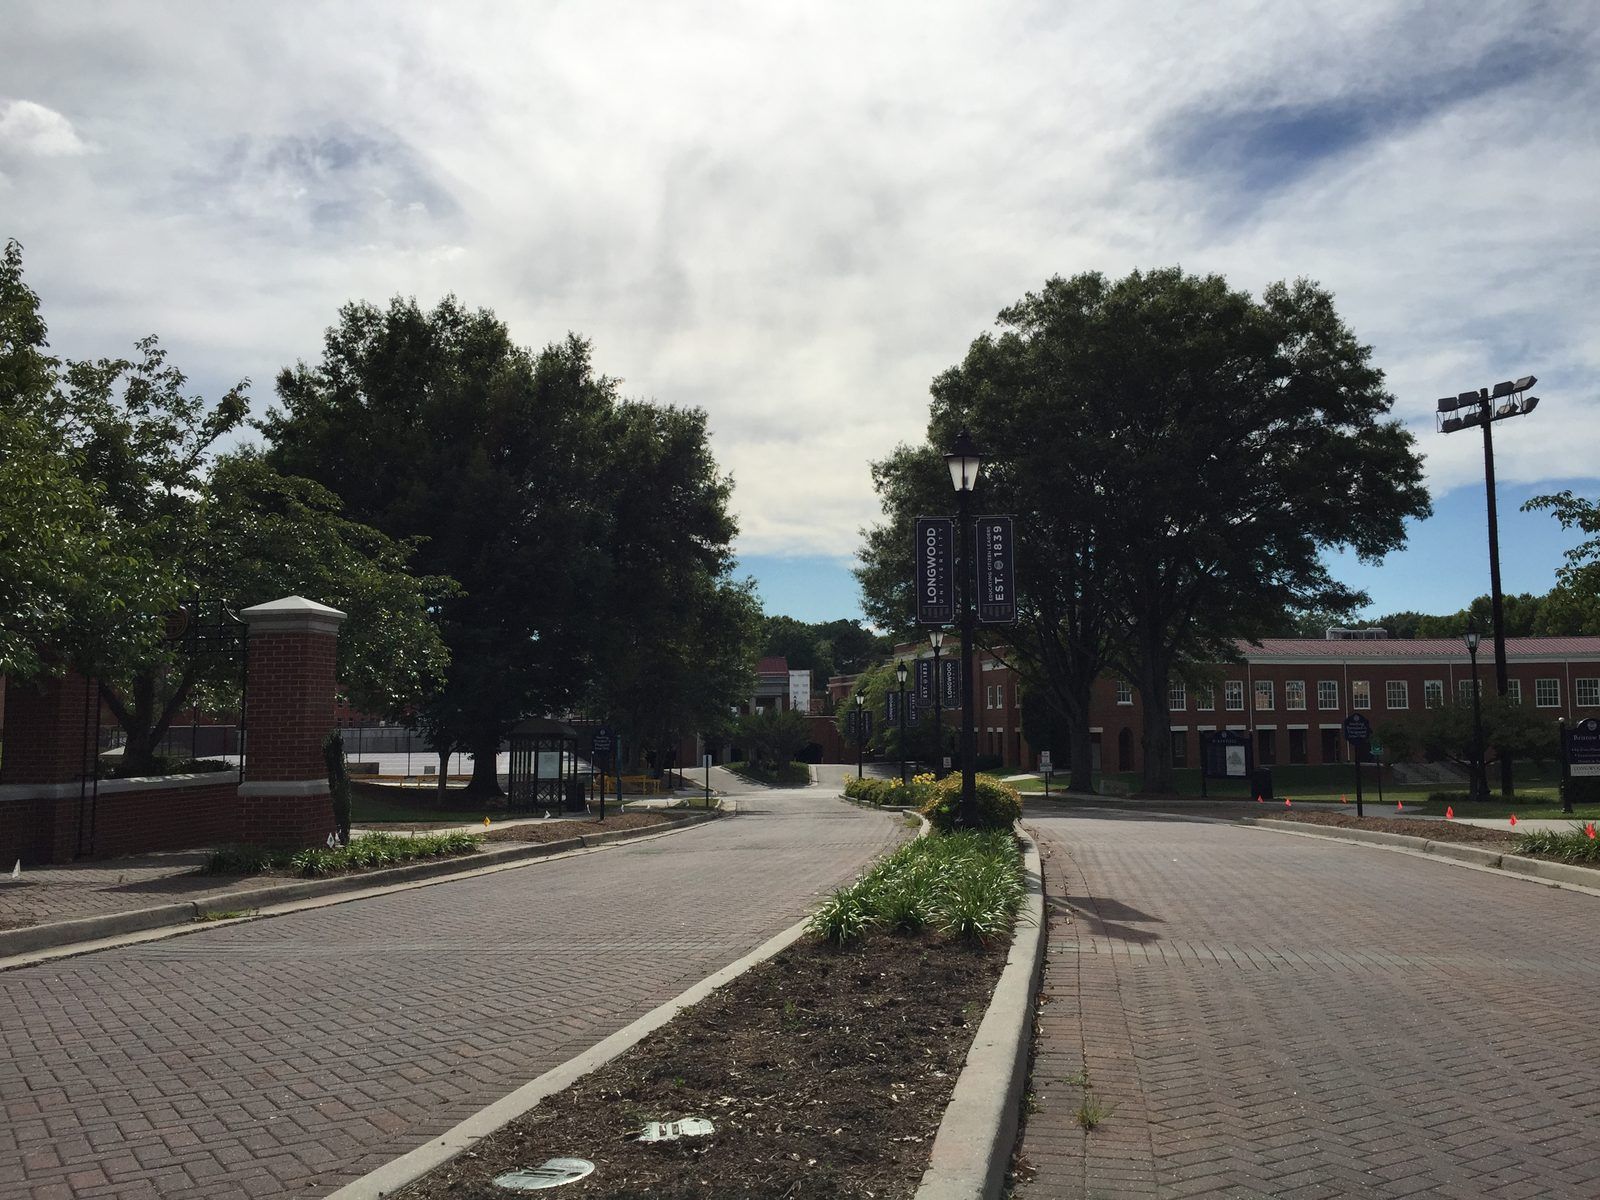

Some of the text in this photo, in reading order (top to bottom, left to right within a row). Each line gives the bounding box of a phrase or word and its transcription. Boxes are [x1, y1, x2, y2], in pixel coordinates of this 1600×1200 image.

[927, 527, 936, 604] LONGWOOD
[993, 525, 1004, 601] EST. 1839
